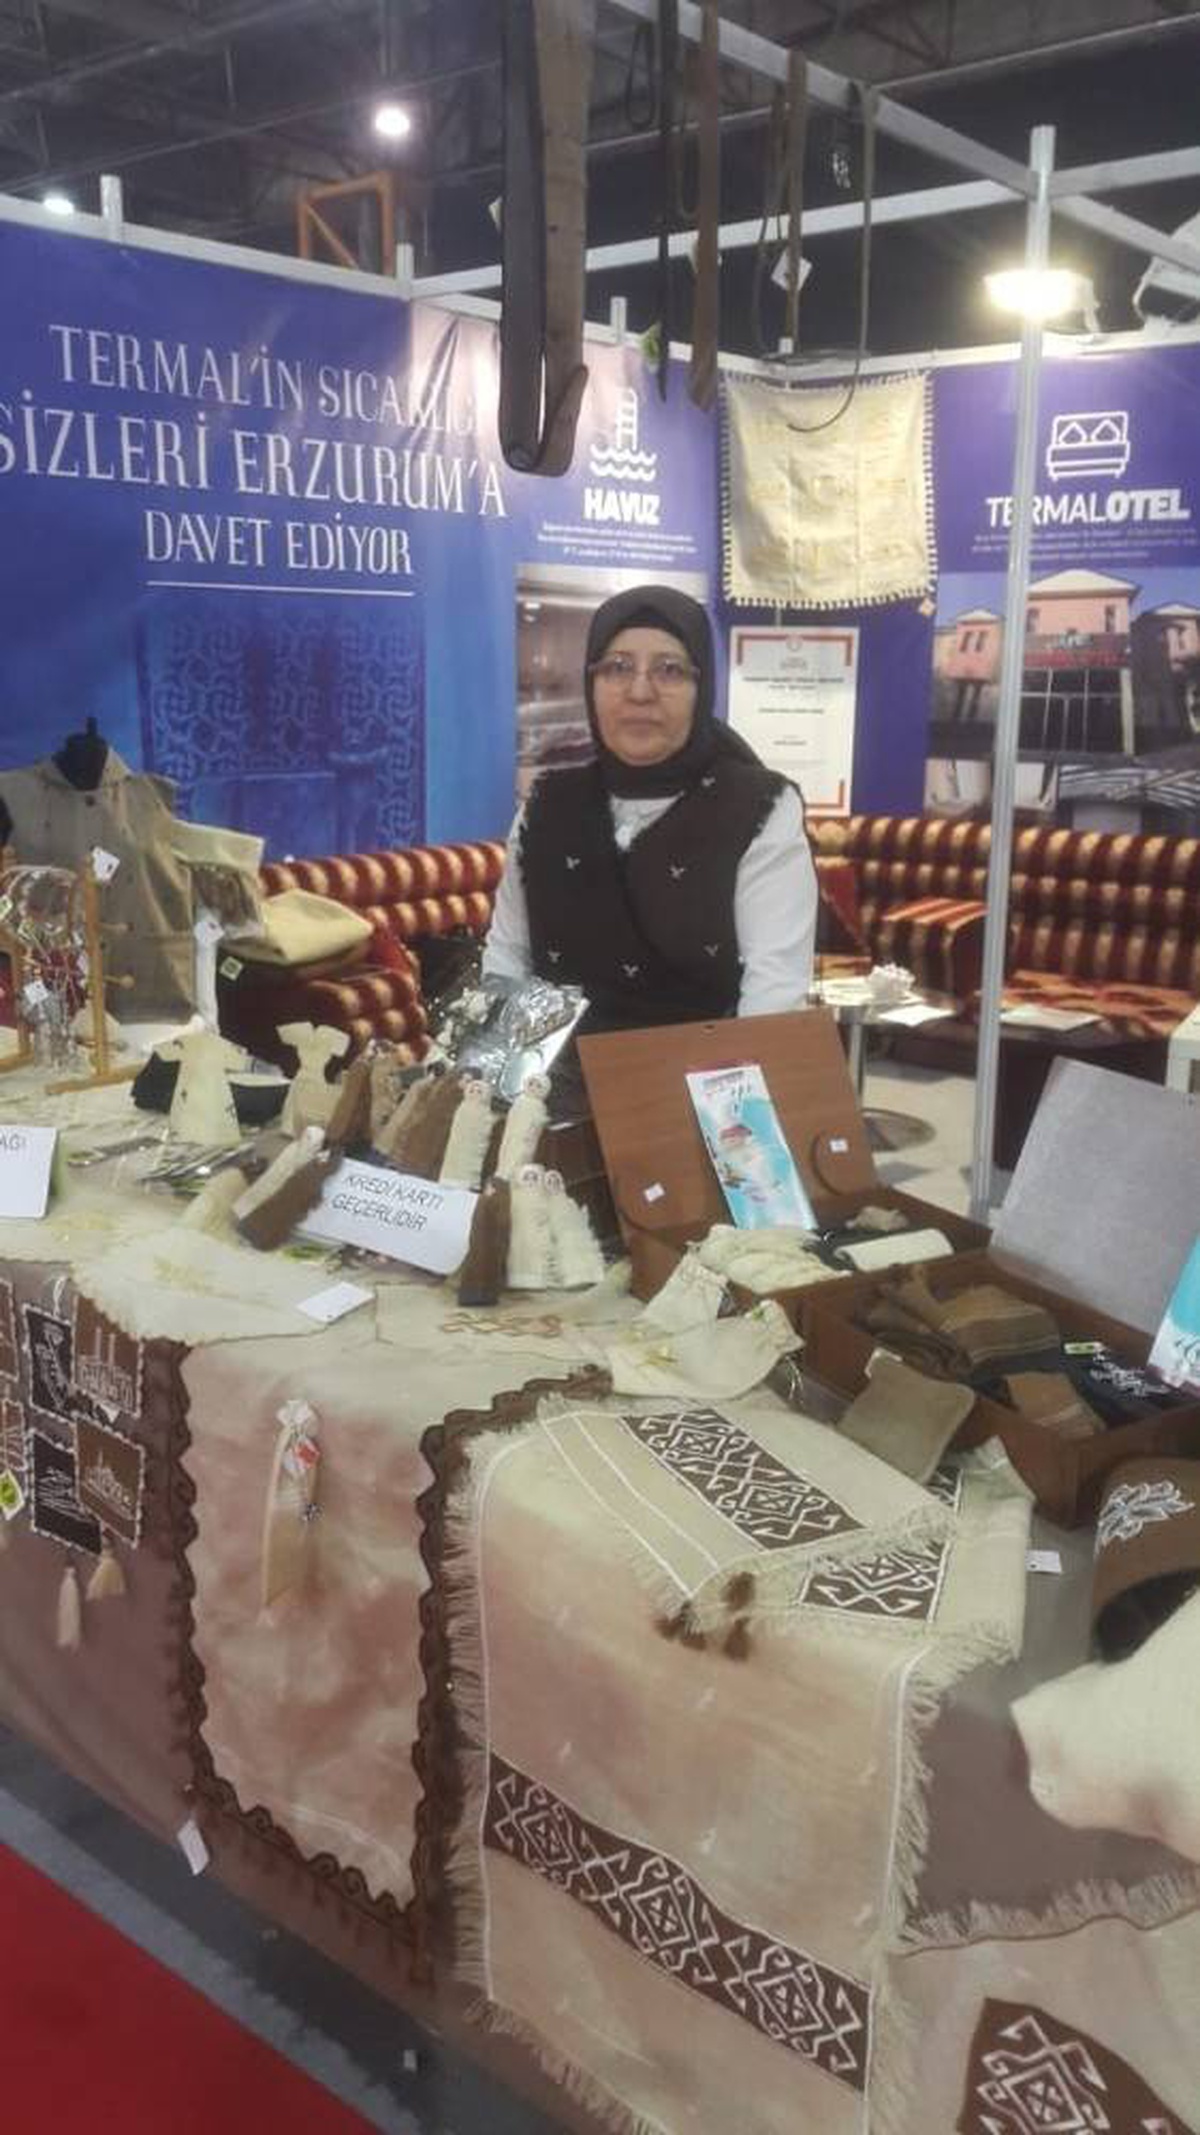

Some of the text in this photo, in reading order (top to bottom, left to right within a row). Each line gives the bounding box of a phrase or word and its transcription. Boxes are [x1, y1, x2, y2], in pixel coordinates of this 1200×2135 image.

[0, 389, 508, 518] SİZLERİ ERZURUM'A
[584, 487, 661, 526] HAVUZ
[145, 509, 415, 575] DAVET EDİYOR
